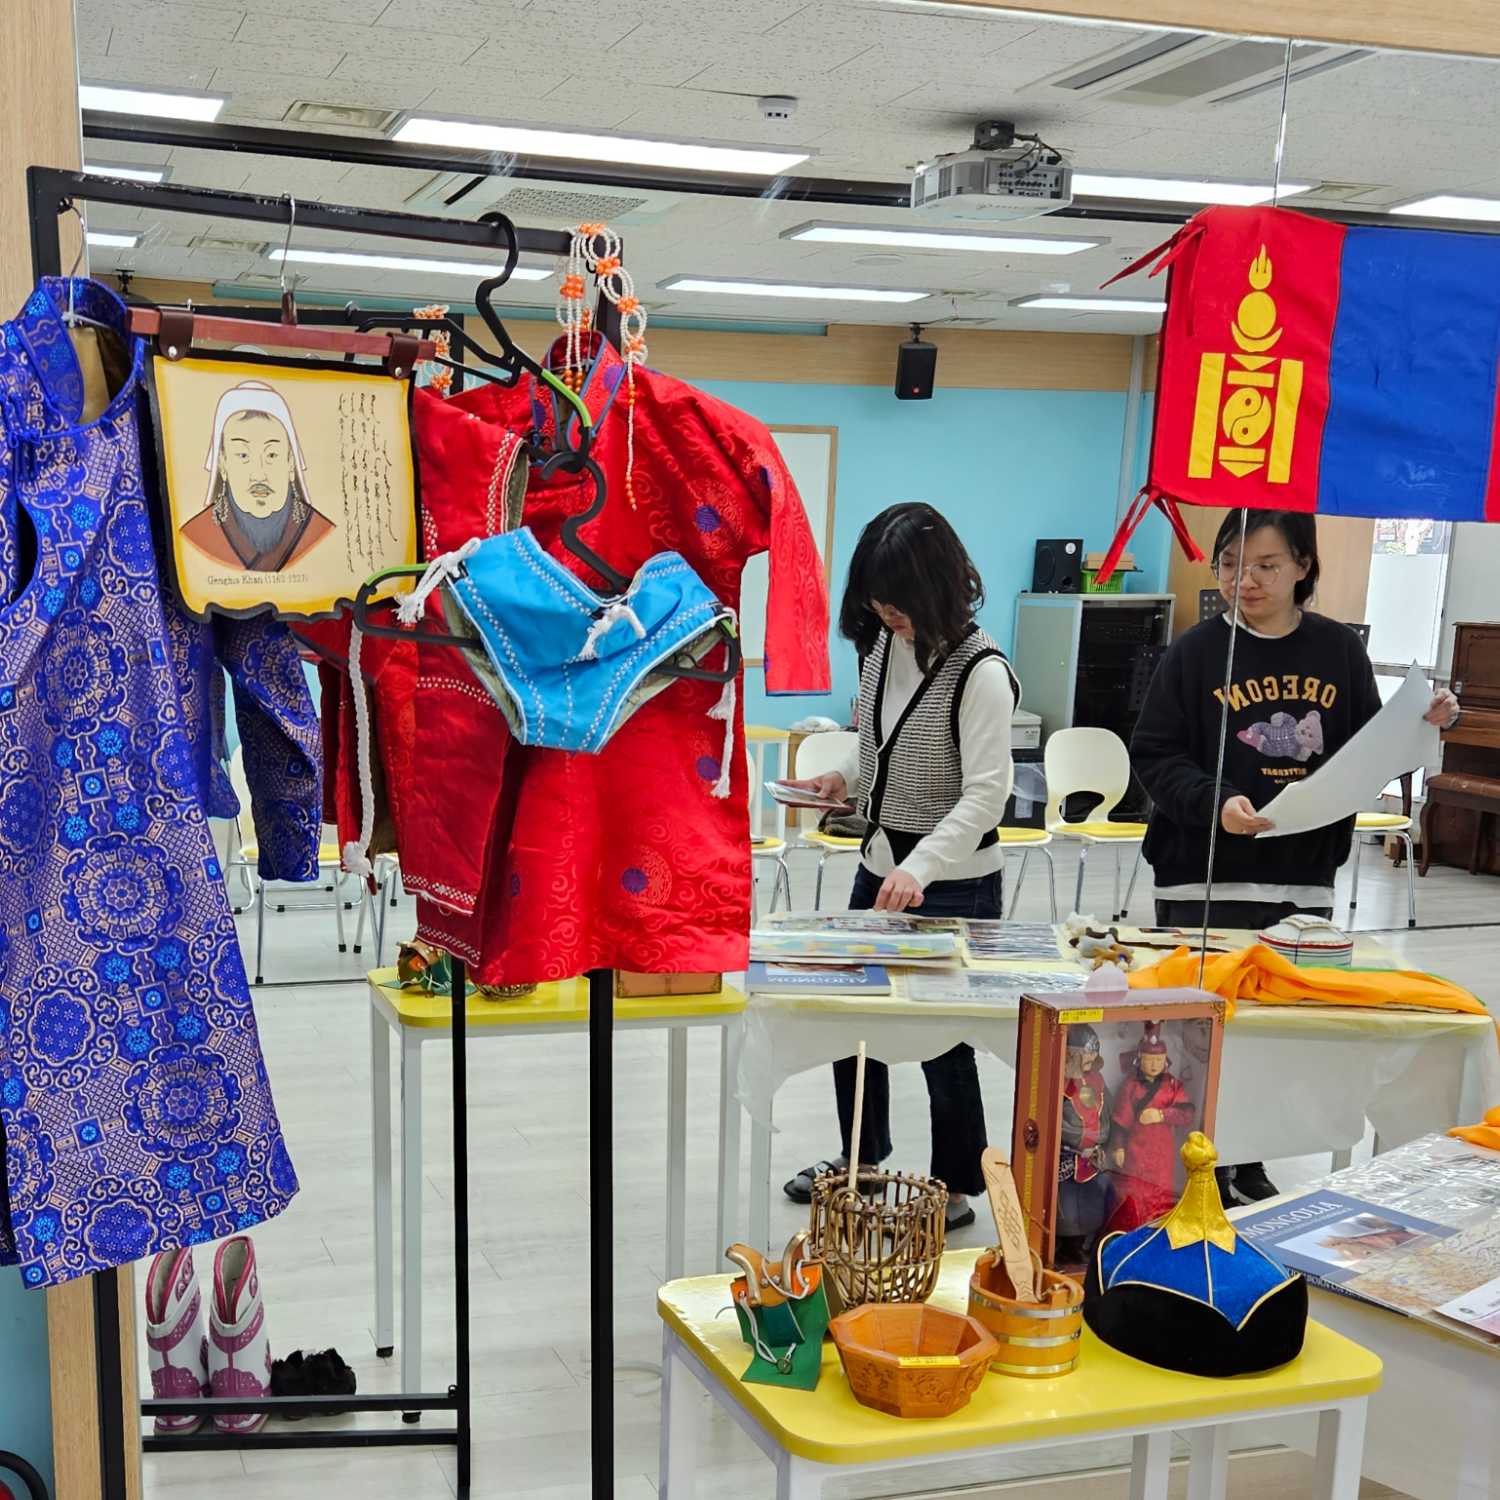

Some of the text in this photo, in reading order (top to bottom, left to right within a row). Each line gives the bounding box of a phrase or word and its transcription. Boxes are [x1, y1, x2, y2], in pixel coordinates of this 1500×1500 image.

[207, 575, 240, 586] Genghis
[242, 575, 263, 584] Khan
[1240, 1201, 1343, 1239] MONGOLIA
